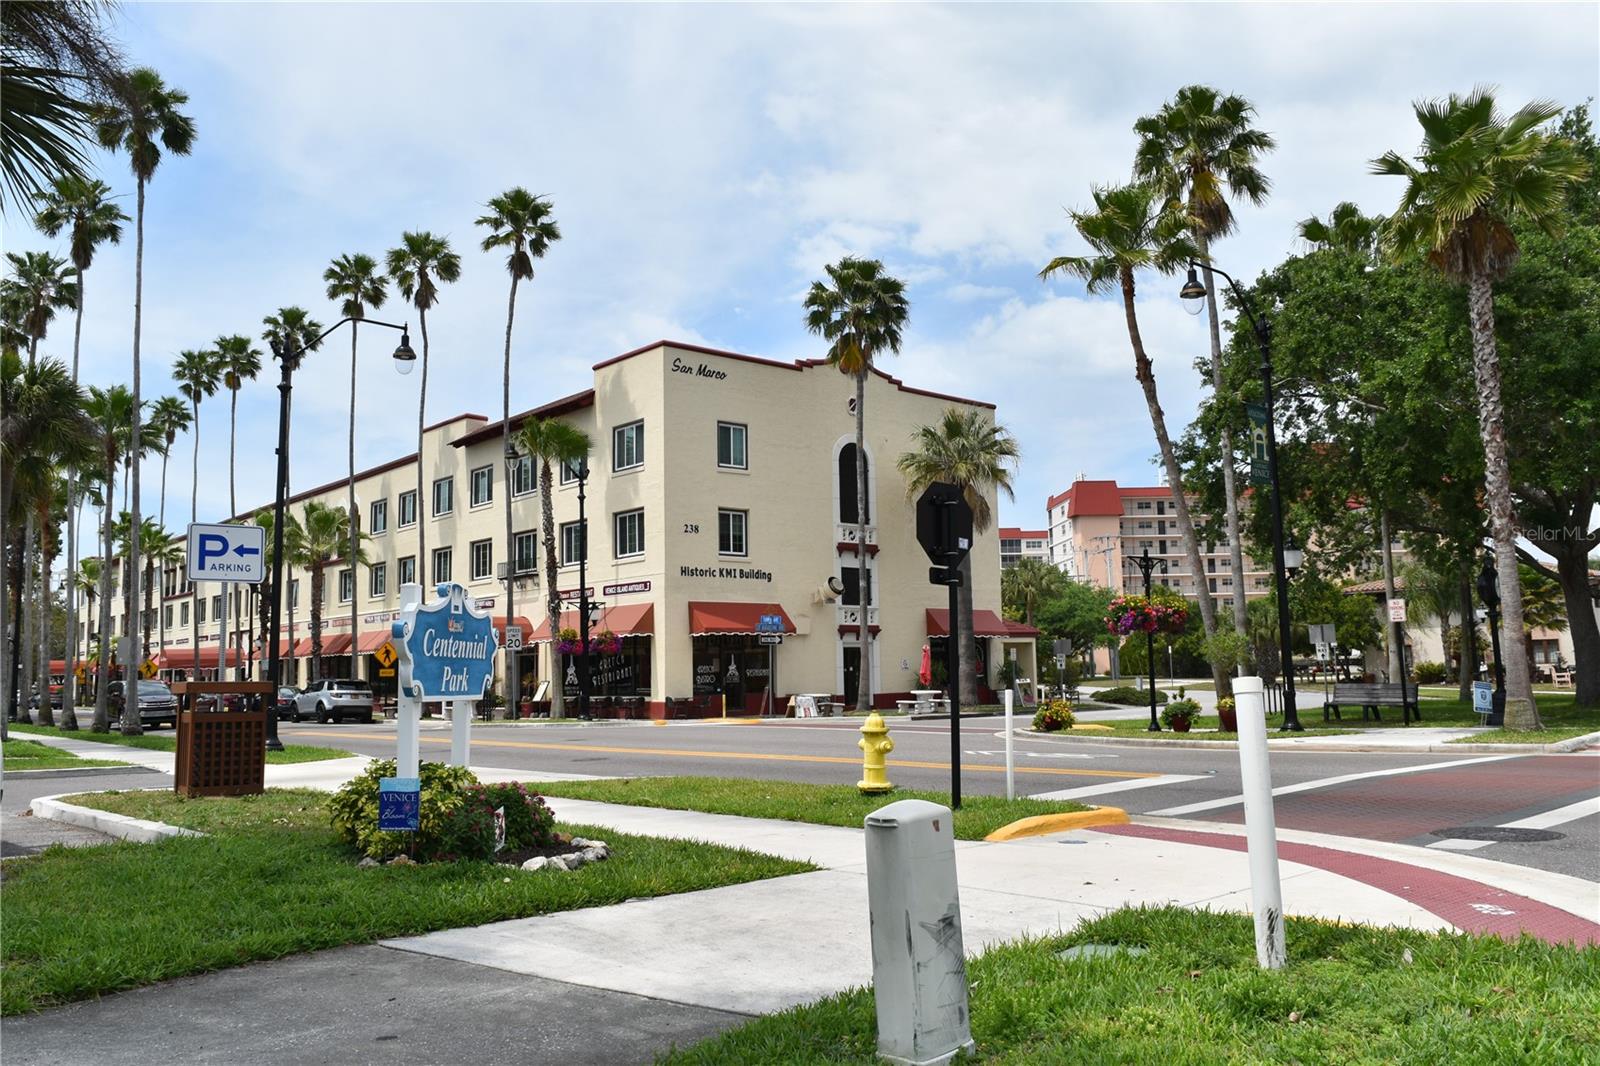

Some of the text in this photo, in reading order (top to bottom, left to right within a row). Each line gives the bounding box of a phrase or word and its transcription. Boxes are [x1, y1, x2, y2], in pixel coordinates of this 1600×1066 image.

[672, 357, 728, 380] San Marco
[683, 523, 699, 534] 238
[680, 566, 772, 583] Historic KMI Building
[423, 628, 487, 660] Centennial
[507, 638, 521, 648] 20
[440, 666, 469, 692] Park
[383, 793, 417, 802] VENICE
